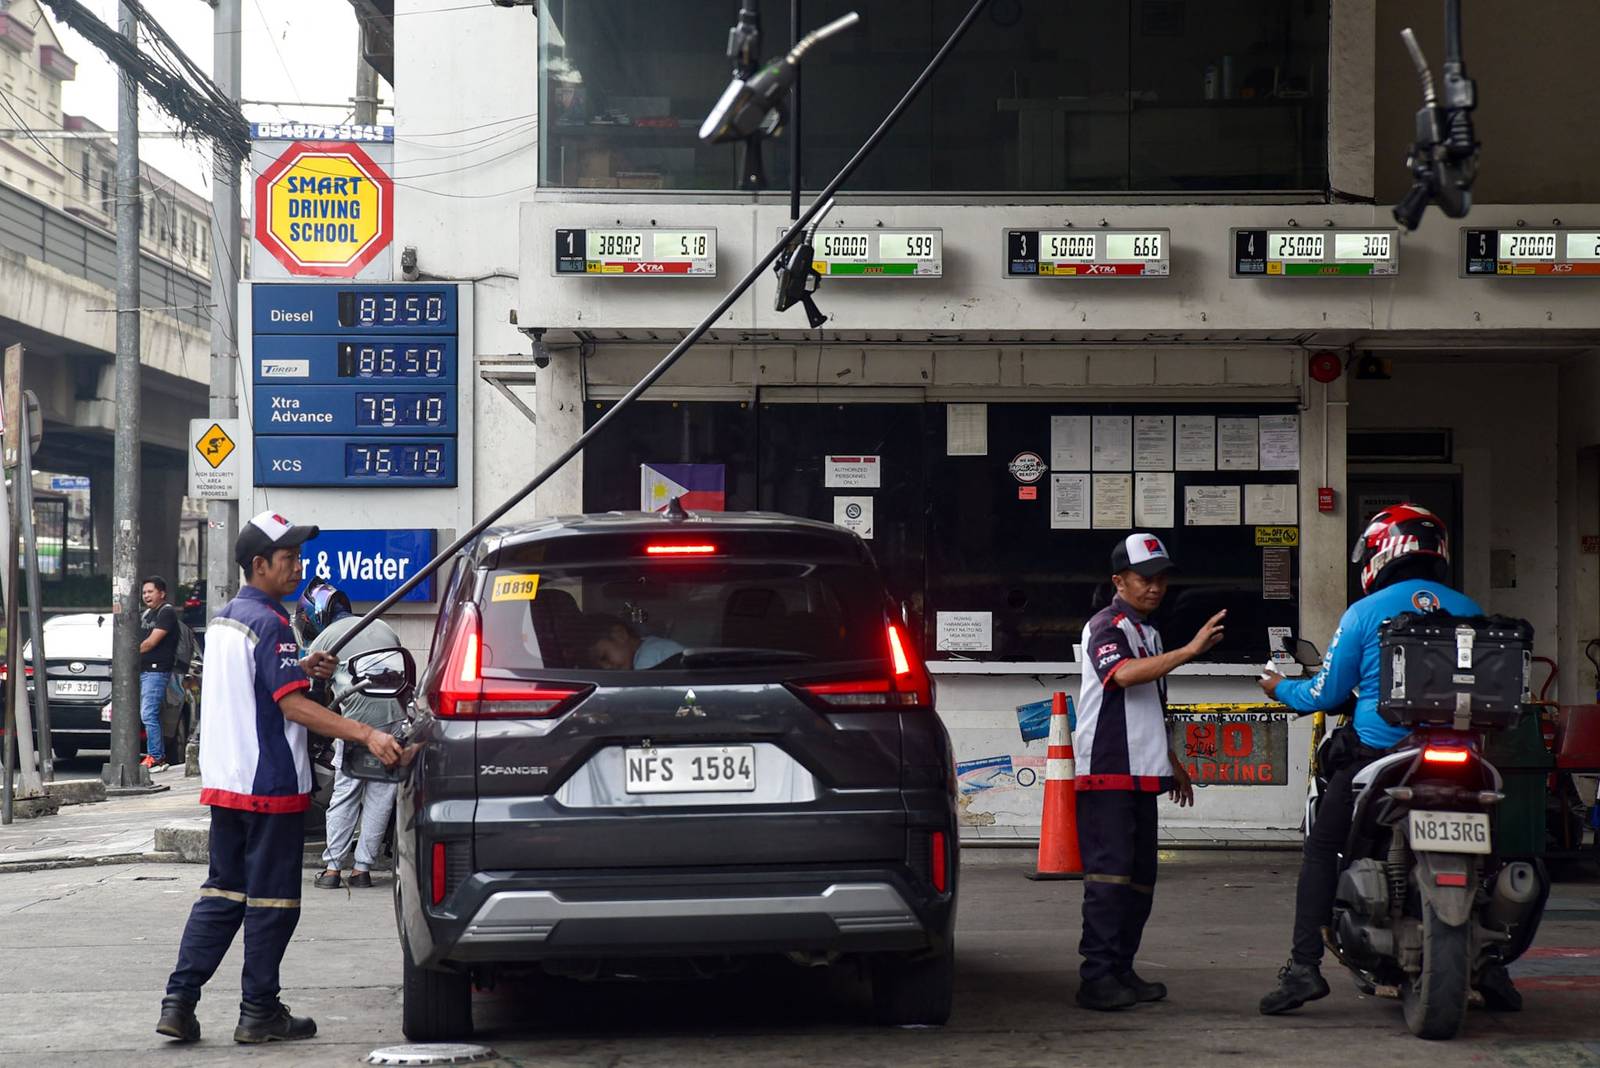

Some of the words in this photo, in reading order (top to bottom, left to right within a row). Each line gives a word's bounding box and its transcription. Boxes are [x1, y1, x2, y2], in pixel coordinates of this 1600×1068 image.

[287, 176, 363, 195] SMART
[288, 199, 360, 219] DRIVING
[290, 223, 358, 243] SCHOOL
[567, 232, 574, 254] 1
[599, 236, 641, 255] 389.02
[681, 236, 706, 255] 5.18
[824, 237, 867, 256] 500.00
[907, 237, 932, 256] 5.99
[1020, 234, 1027, 256] 3
[1051, 237, 1094, 256] 500.00
[1134, 237, 1158, 256] 6.66
[1248, 234, 1255, 256] 4
[1279, 237, 1322, 256] 250.00
[1362, 237, 1388, 256] 3.00
[1479, 234, 1486, 255] 5
[1510, 236, 1554, 256] 200.00
[633, 263, 664, 272] XTRA
[1086, 264, 1117, 274] XTRA
[1552, 264, 1573, 272] XCS
[271, 310, 313, 321] Diesel
[360, 349, 441, 372] 86.50
[271, 397, 300, 408] Xtra
[271, 410, 333, 422] Advance
[272, 460, 302, 471] XCS
[357, 449, 440, 472] 76.10
[316, 551, 331, 579] &
[338, 551, 409, 579] Water
[1097, 643, 1118, 657] XCS
[1229, 714, 1257, 722] YOUR
[1260, 714, 1288, 722] CASH
[480, 765, 549, 775] XPANDER
[629, 757, 673, 782] NFS
[691, 756, 751, 781] 1584
[1415, 820, 1486, 842] N813RG
